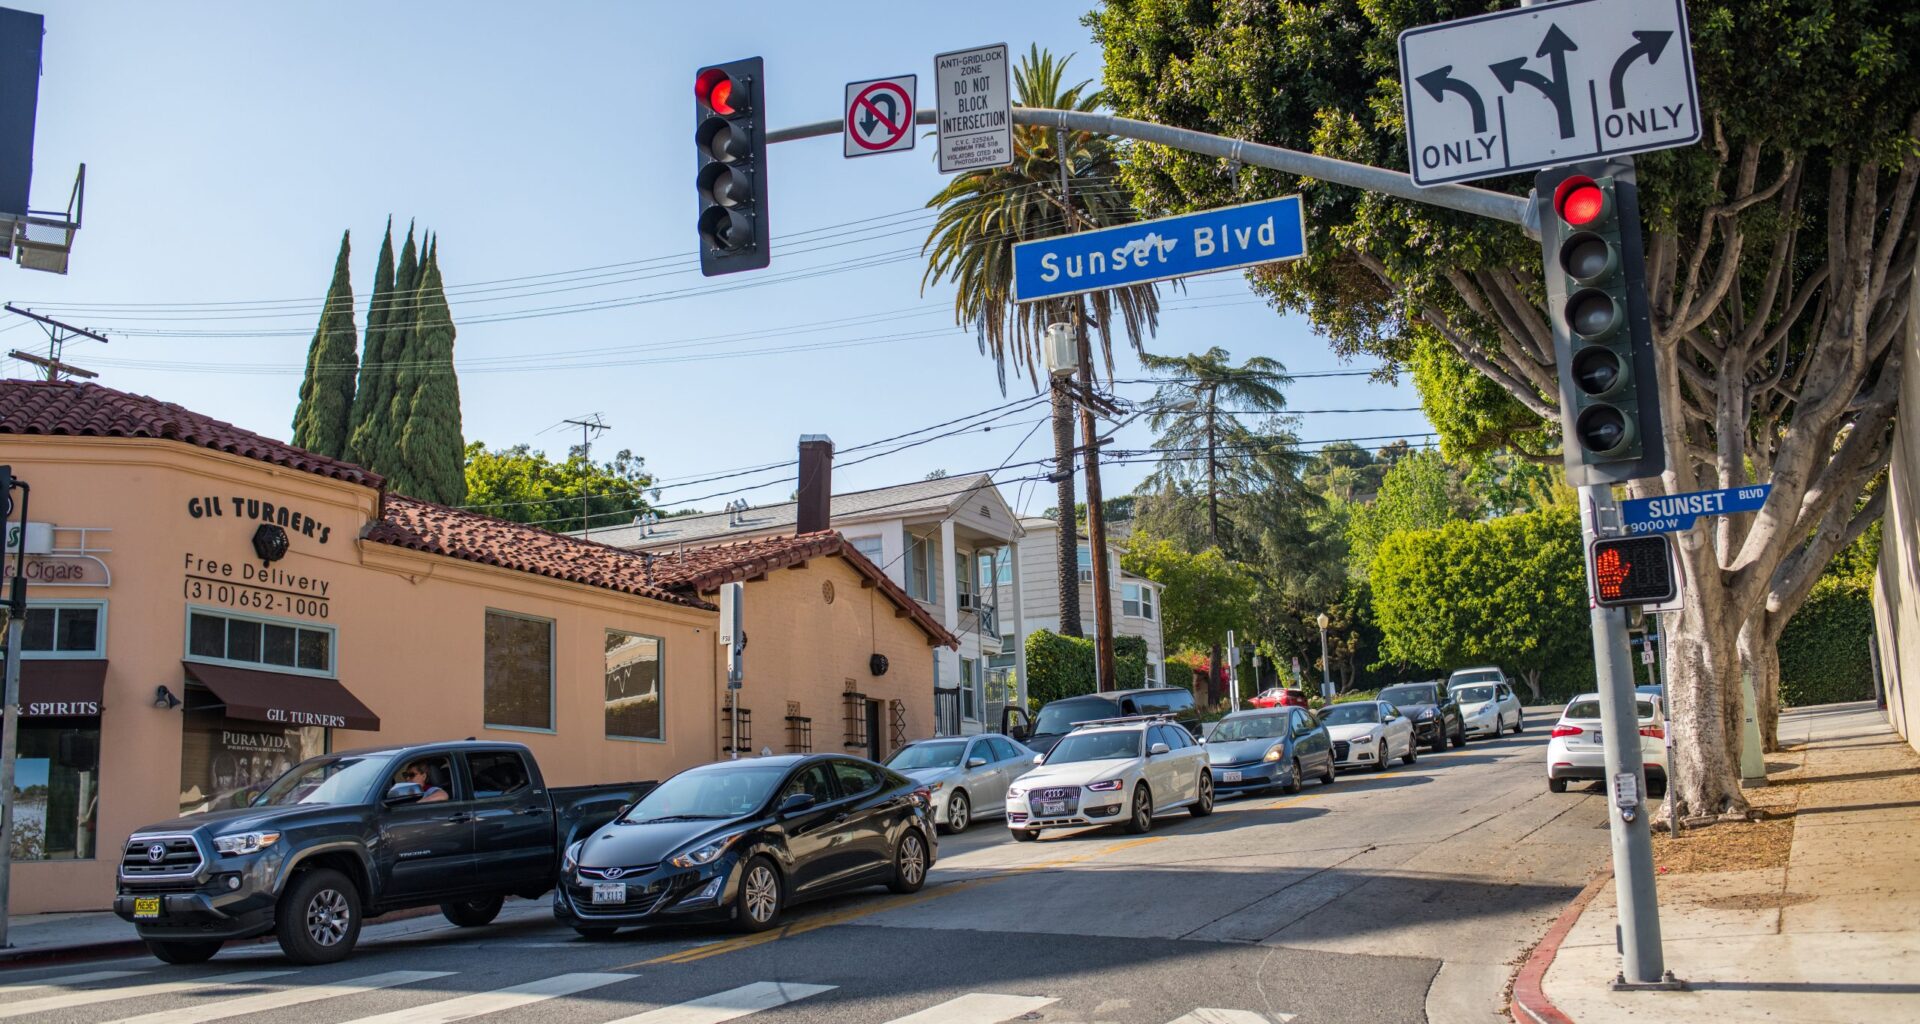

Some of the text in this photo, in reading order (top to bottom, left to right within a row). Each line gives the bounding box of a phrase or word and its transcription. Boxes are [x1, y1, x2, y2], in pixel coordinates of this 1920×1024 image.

[940, 51, 1002, 69] ANTI-GRIDLOCK
[961, 65, 982, 76] ZONE
[954, 76, 990, 96] DO NOT
[958, 95, 988, 113] BLOCK
[943, 111, 1006, 134] INTERSECTION
[1604, 103, 1684, 139] ONLY
[954, 155, 997, 166] PHOTOGRAPHED
[1422, 135, 1497, 169] ONLY
[1040, 216, 1276, 282] Sunset Blvd
[1648, 488, 1764, 518] SUNSET BLVD
[188, 496, 331, 545] GIL TURNER'S
[1631, 518, 1679, 533] 9000 W
[26, 560, 83, 582] Cigars
[185, 553, 330, 596] Free Delivery
[184, 578, 330, 618] (310)652-1000
[29, 701, 98, 716] SPIRITS
[266, 708, 345, 728] GIL TURNER'S
[222, 730, 292, 748] PURA VIDA
